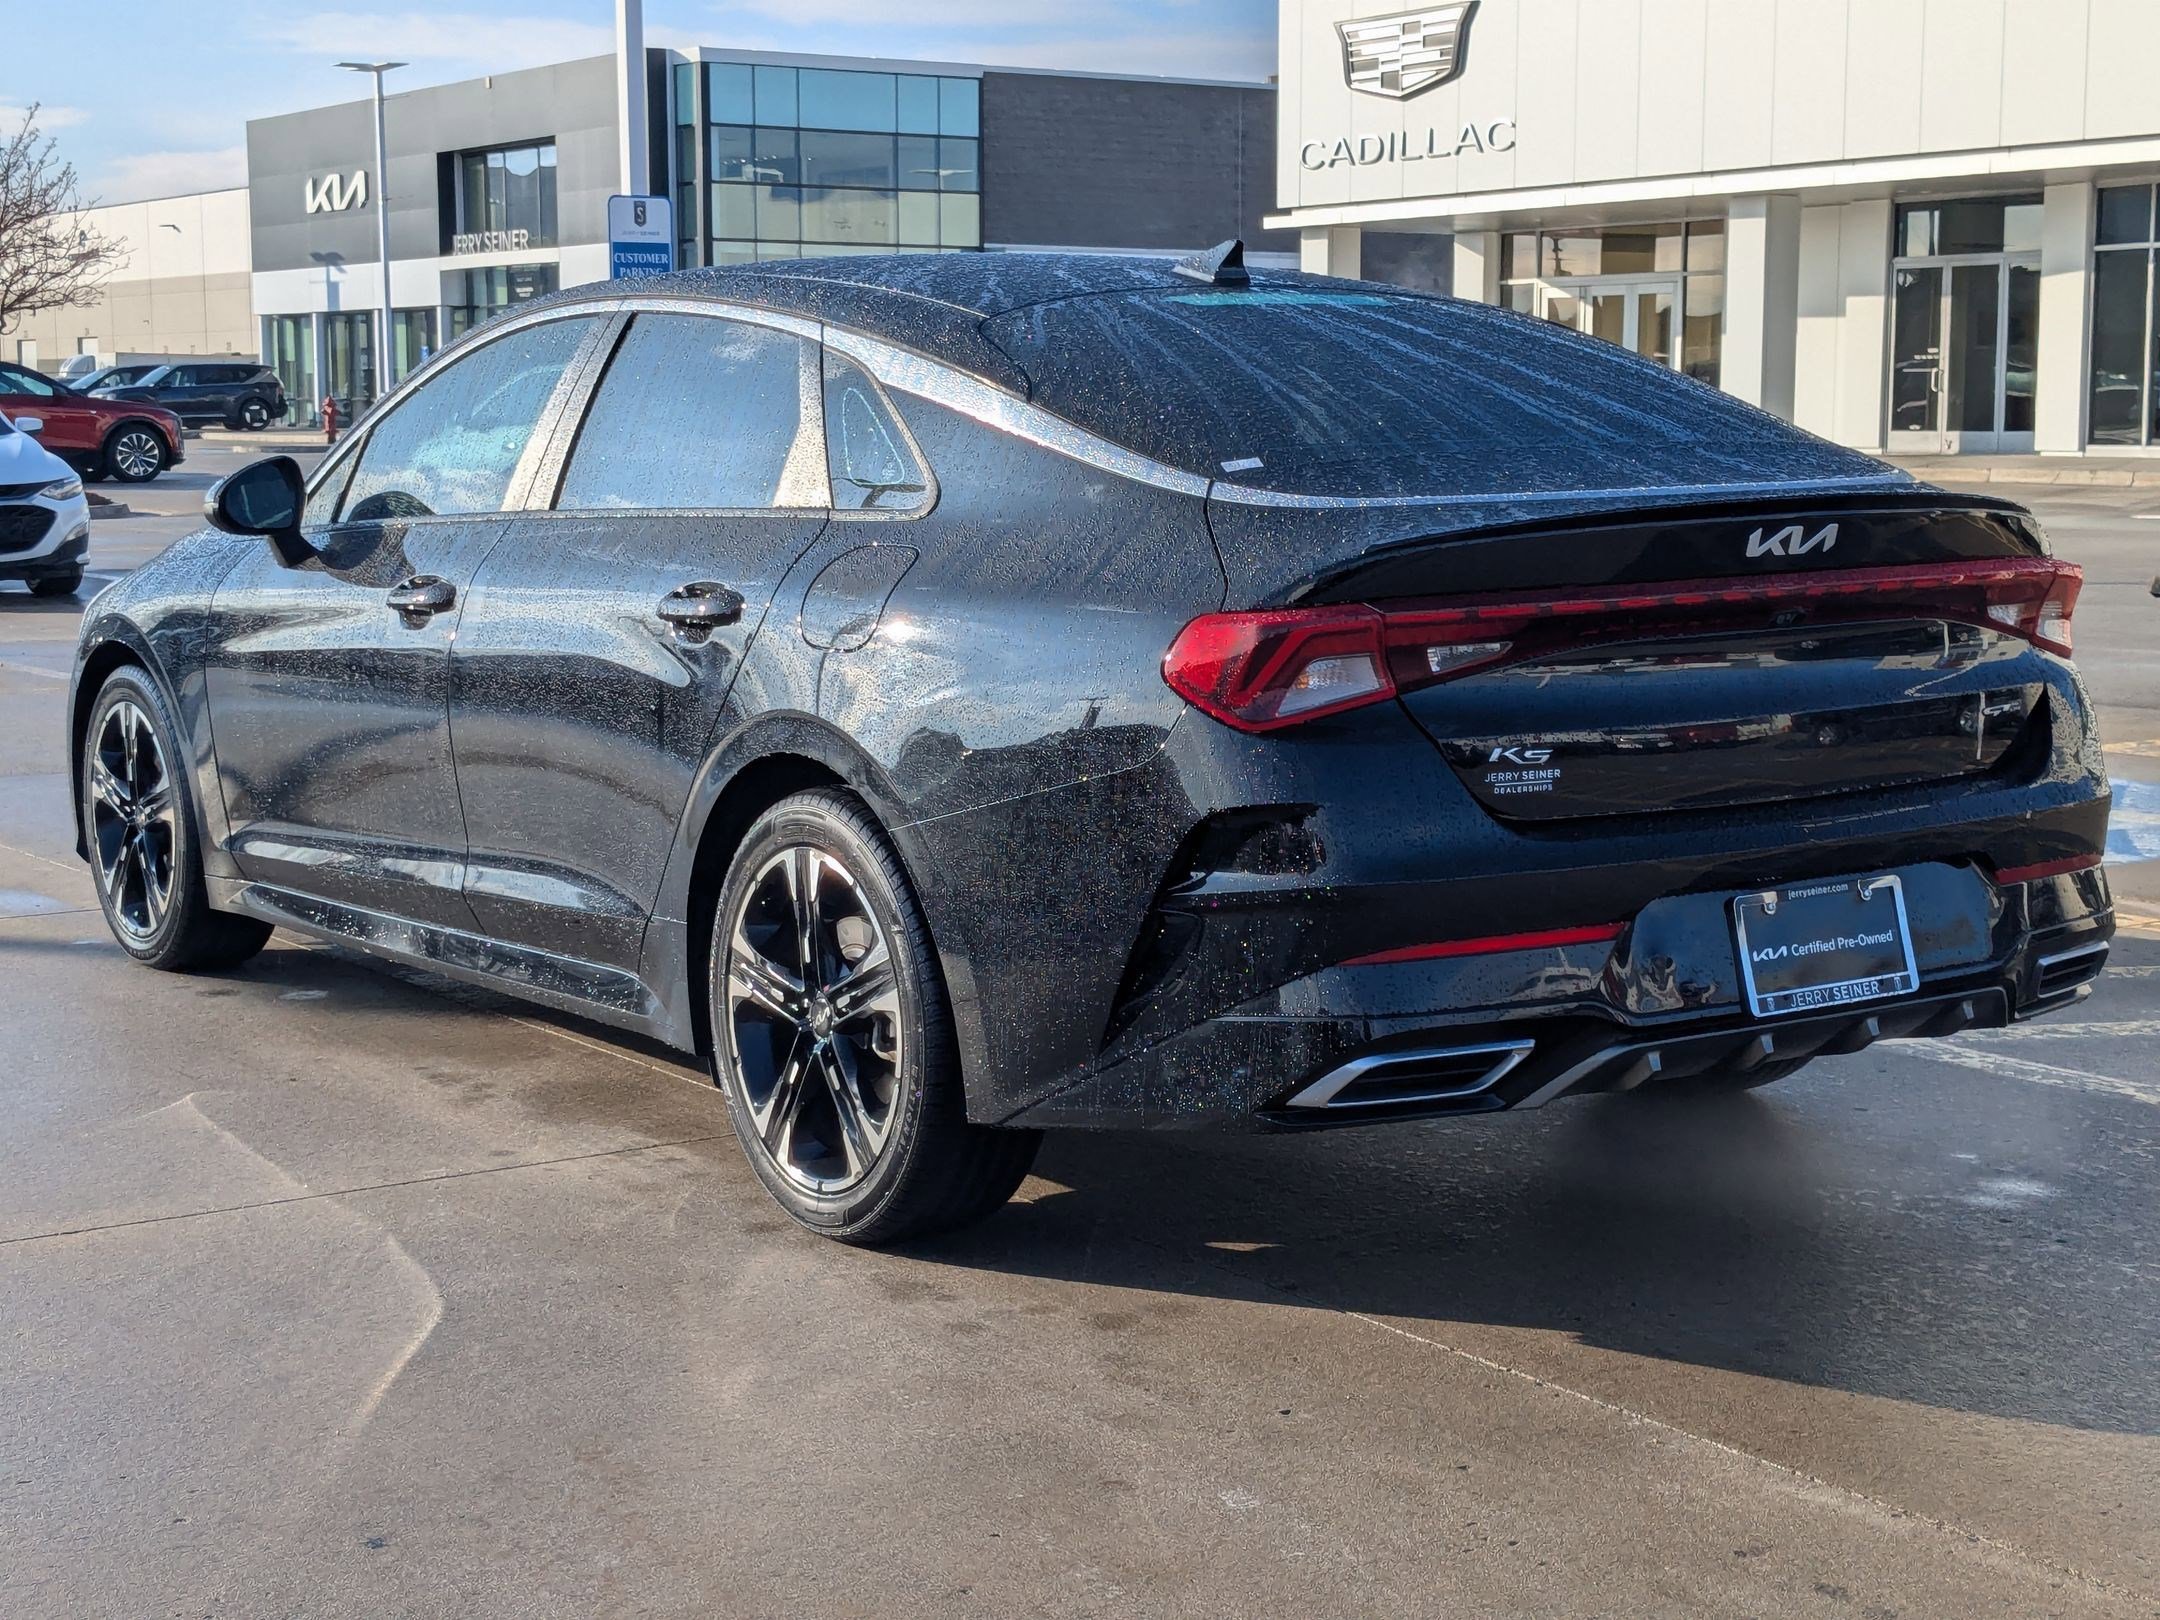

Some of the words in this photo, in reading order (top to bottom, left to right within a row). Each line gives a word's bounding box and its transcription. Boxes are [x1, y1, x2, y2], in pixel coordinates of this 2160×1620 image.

[1301, 121, 1516, 170] CADILLAC
[305, 170, 366, 214] KIA
[453, 234, 482, 256] JERRY
[484, 229, 529, 253] SEINER
[614, 252, 668, 264] CUSTOMER
[1746, 523, 1839, 557] KIA
[1489, 747, 1554, 765] K5
[1485, 772, 1519, 782] JERRY
[1522, 769, 1561, 780] SEINER
[1494, 784, 1553, 794] DEALERSHIPS
[1788, 883, 1848, 900] jerryseiner.com
[1753, 945, 1787, 962] KIA
[1791, 939, 1836, 956] Certified
[1837, 930, 1893, 950] Pre-Owned
[1791, 988, 1830, 1008] JERRY
[1833, 980, 1880, 1000] SEINER
